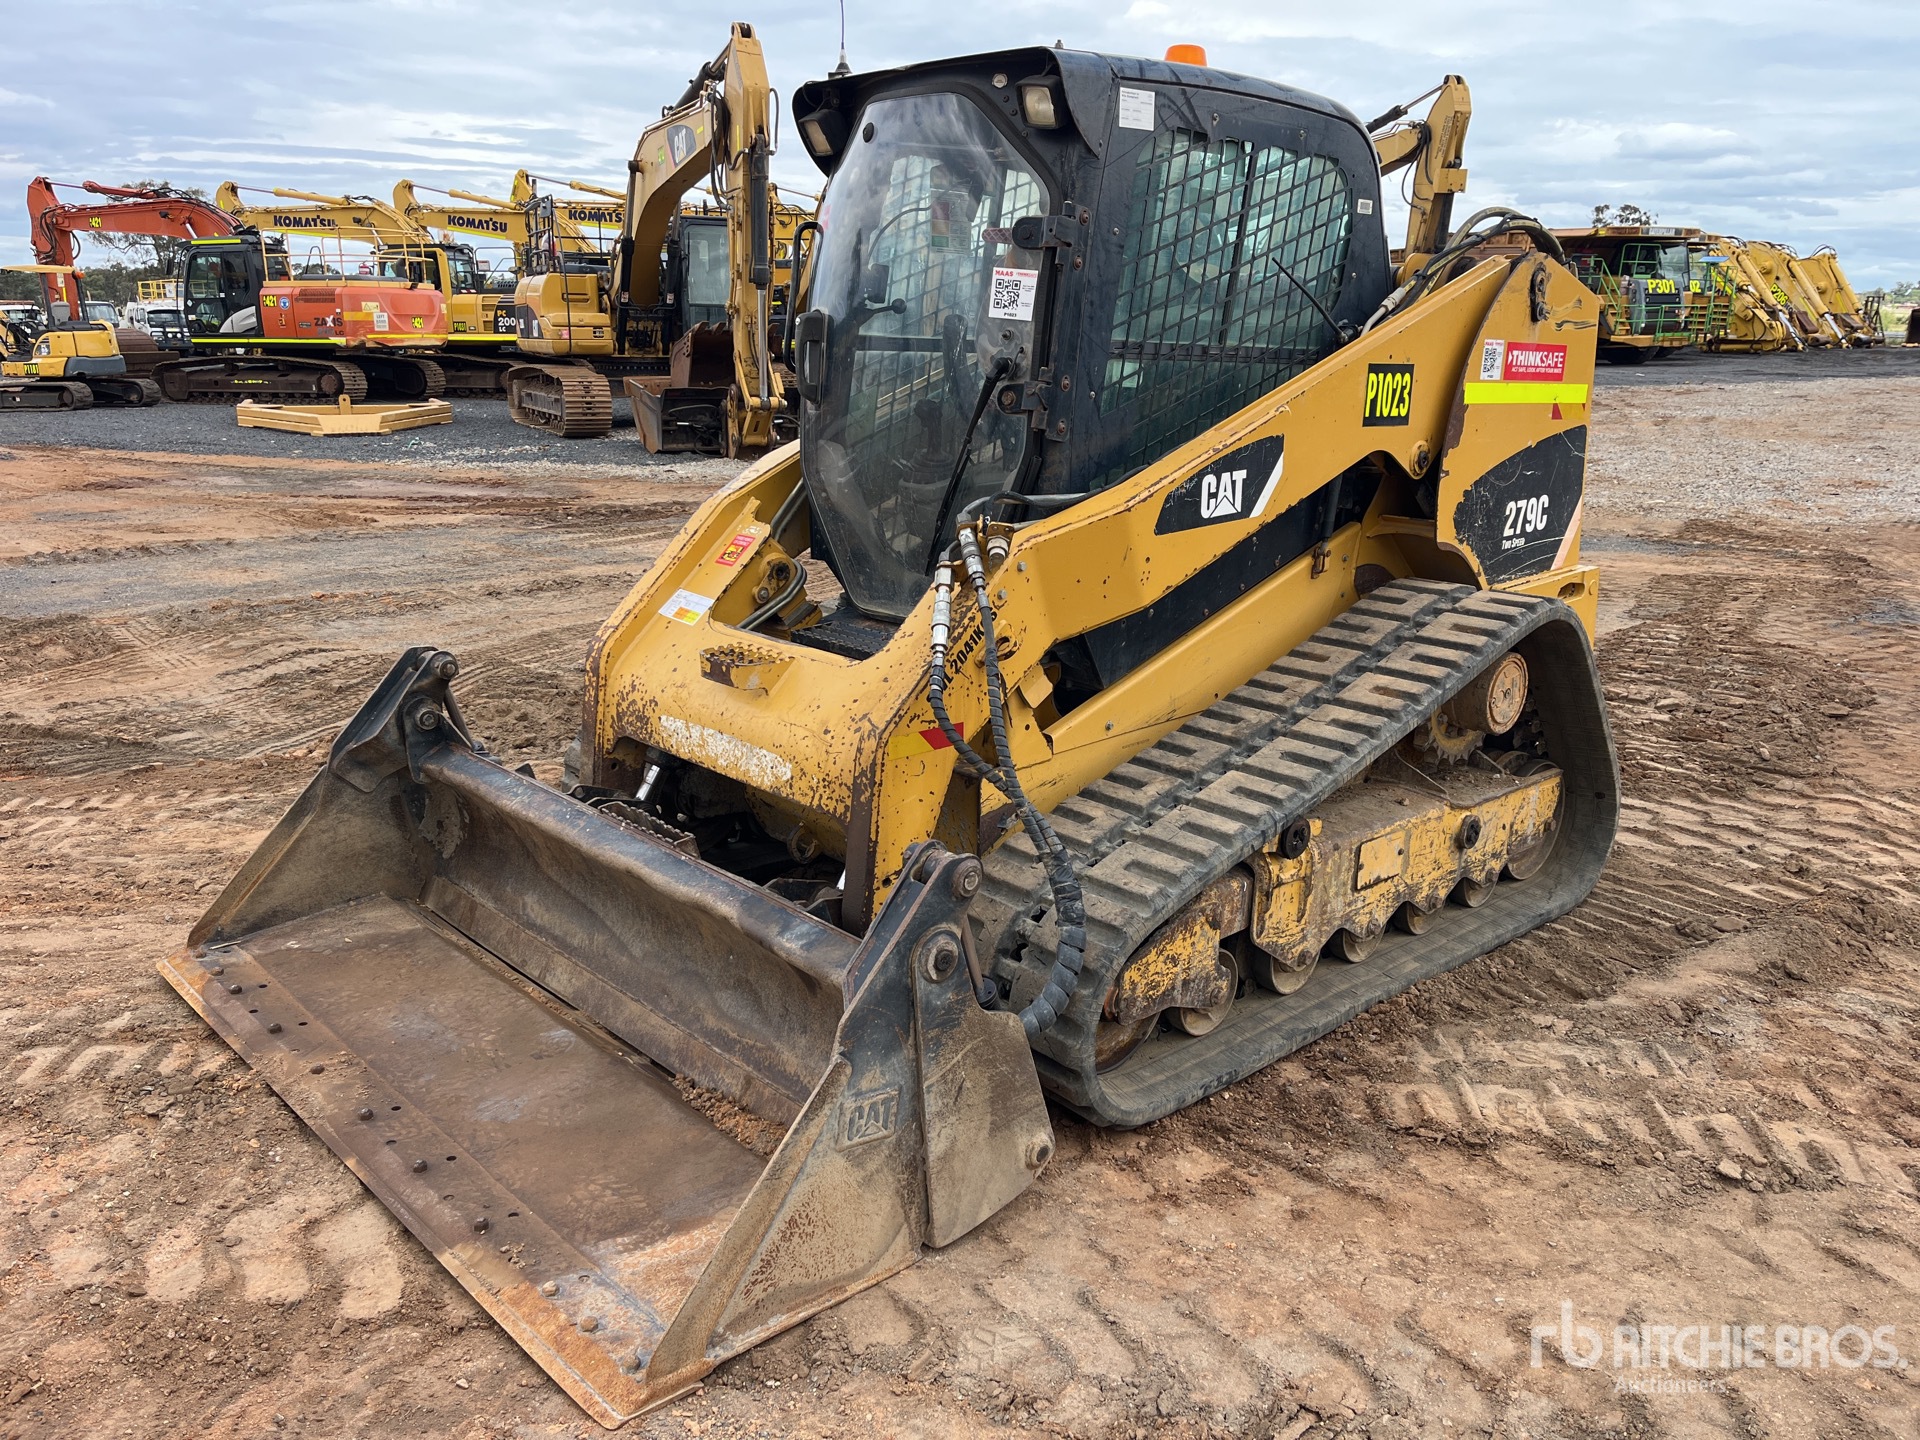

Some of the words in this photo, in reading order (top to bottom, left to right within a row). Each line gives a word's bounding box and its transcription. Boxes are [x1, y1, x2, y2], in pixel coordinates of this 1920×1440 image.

[674, 127, 687, 164] CAT
[447, 214, 508, 233] KOMATSU
[568, 209, 624, 223] KOMATS
[1647, 279, 1676, 294] P301
[1770, 283, 1789, 306] P206
[313, 315, 344, 327] ZAXIS
[497, 309, 507, 317] PC
[498, 317, 516, 326] 200
[1511, 350, 1564, 367] THINKSAFE
[1364, 372, 1411, 418] P1023
[1200, 469, 1247, 519] CAT
[1503, 494, 1549, 537] 279C
[847, 1097, 892, 1141] CAT
